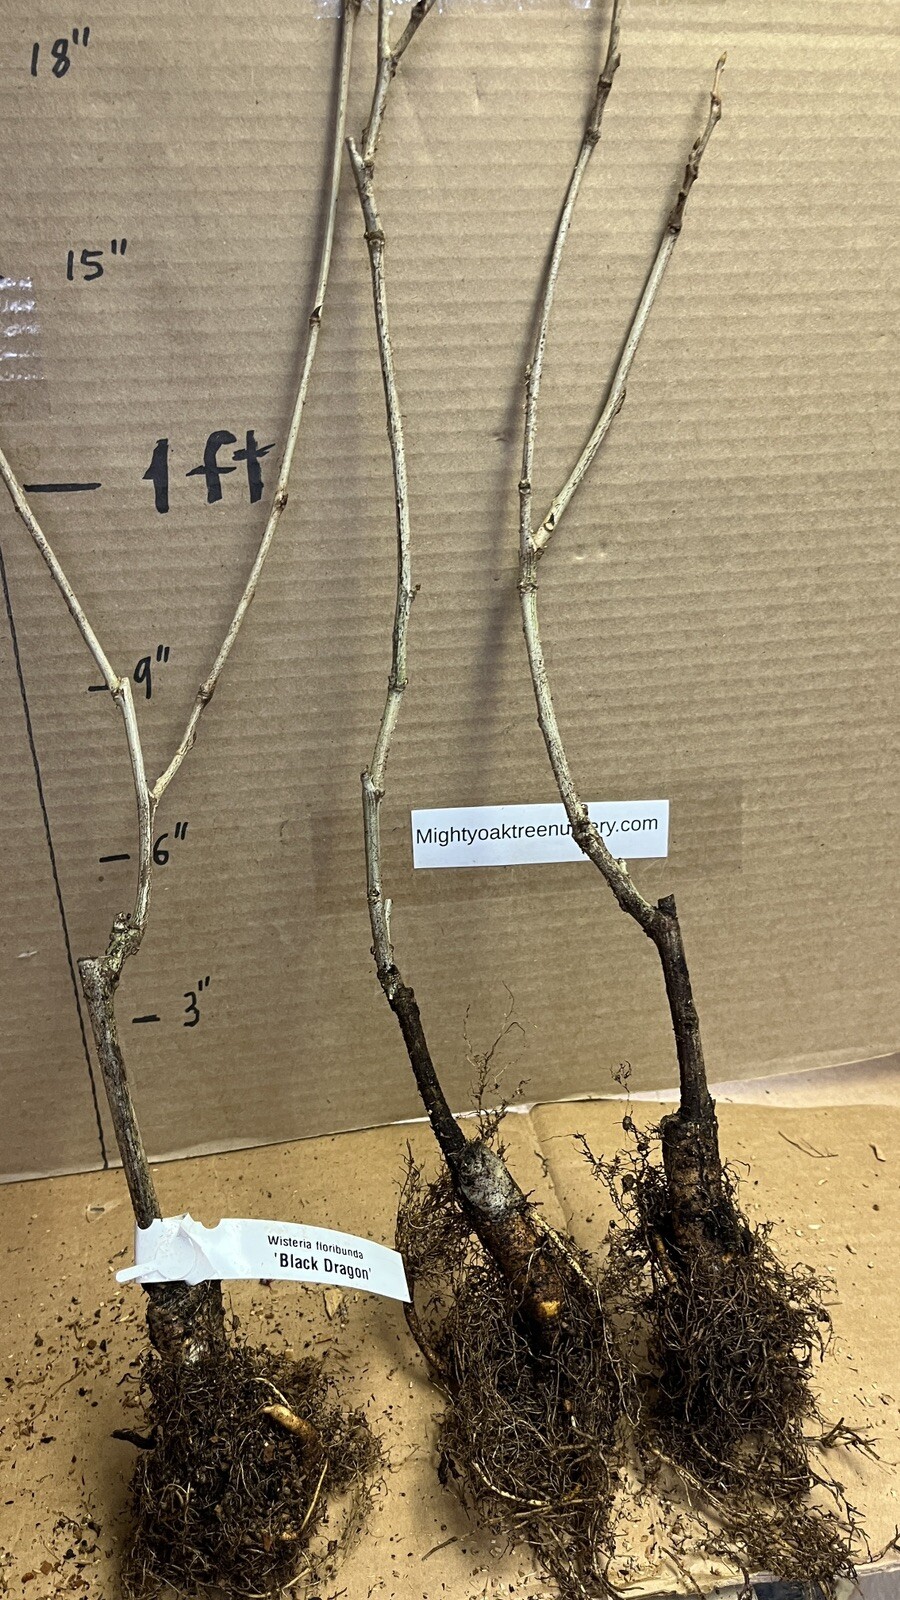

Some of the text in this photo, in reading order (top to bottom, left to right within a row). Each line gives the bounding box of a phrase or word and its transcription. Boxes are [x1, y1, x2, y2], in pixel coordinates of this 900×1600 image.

[30, 27, 90, 78] 18"
[66, 239, 127, 281] 15"
[142, 430, 276, 514] 1 ft
[134, 644, 170, 699] 9"
[152, 822, 188, 866] 6"
[416, 817, 659, 847] Mightyoaktreenuery.com
[183, 976, 211, 1027] 3"
[267, 1235, 364, 1259] Wisteria floribunda
[274, 1252, 372, 1280] 'Black Dragon'
